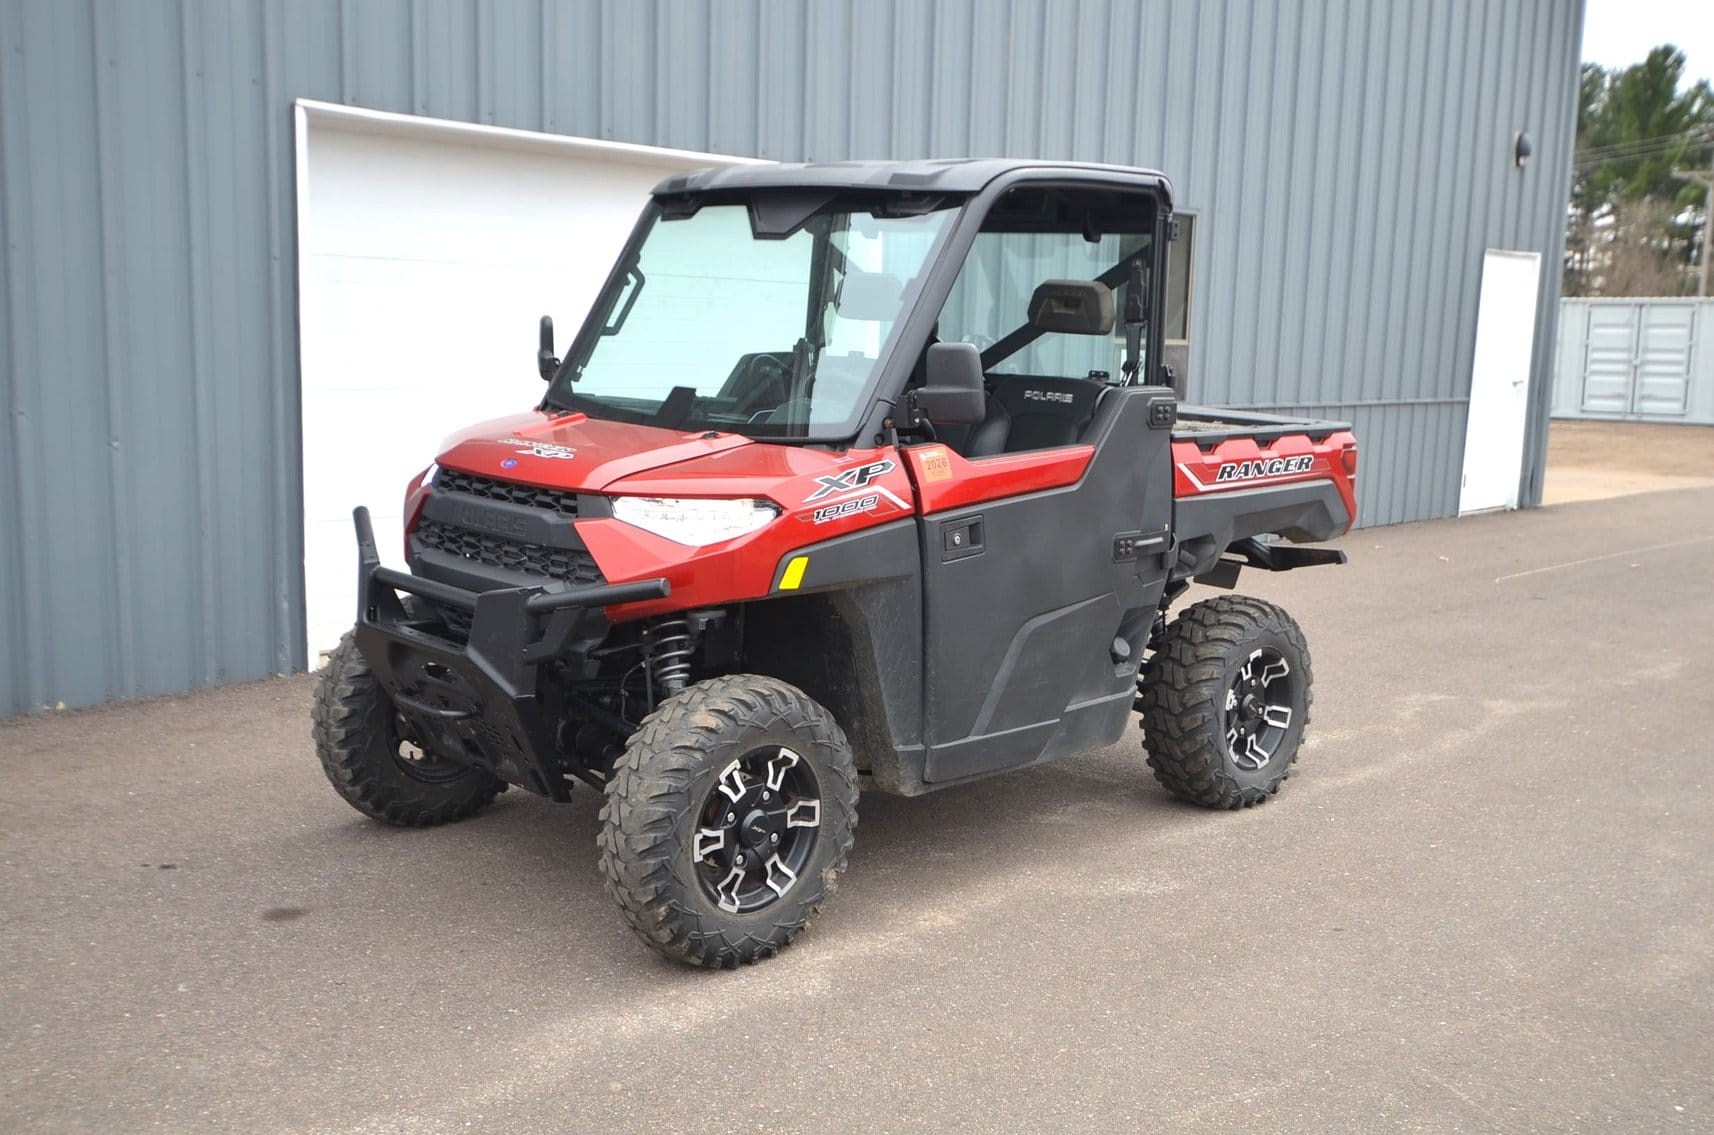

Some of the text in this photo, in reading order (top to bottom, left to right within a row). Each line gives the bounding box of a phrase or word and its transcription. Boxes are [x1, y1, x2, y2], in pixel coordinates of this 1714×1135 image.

[1024, 390, 1074, 403] POLARIS
[926, 457, 948, 471] 2026
[1216, 455, 1314, 483] RANGER
[802, 459, 897, 503] XP
[813, 494, 879, 522] 1000
